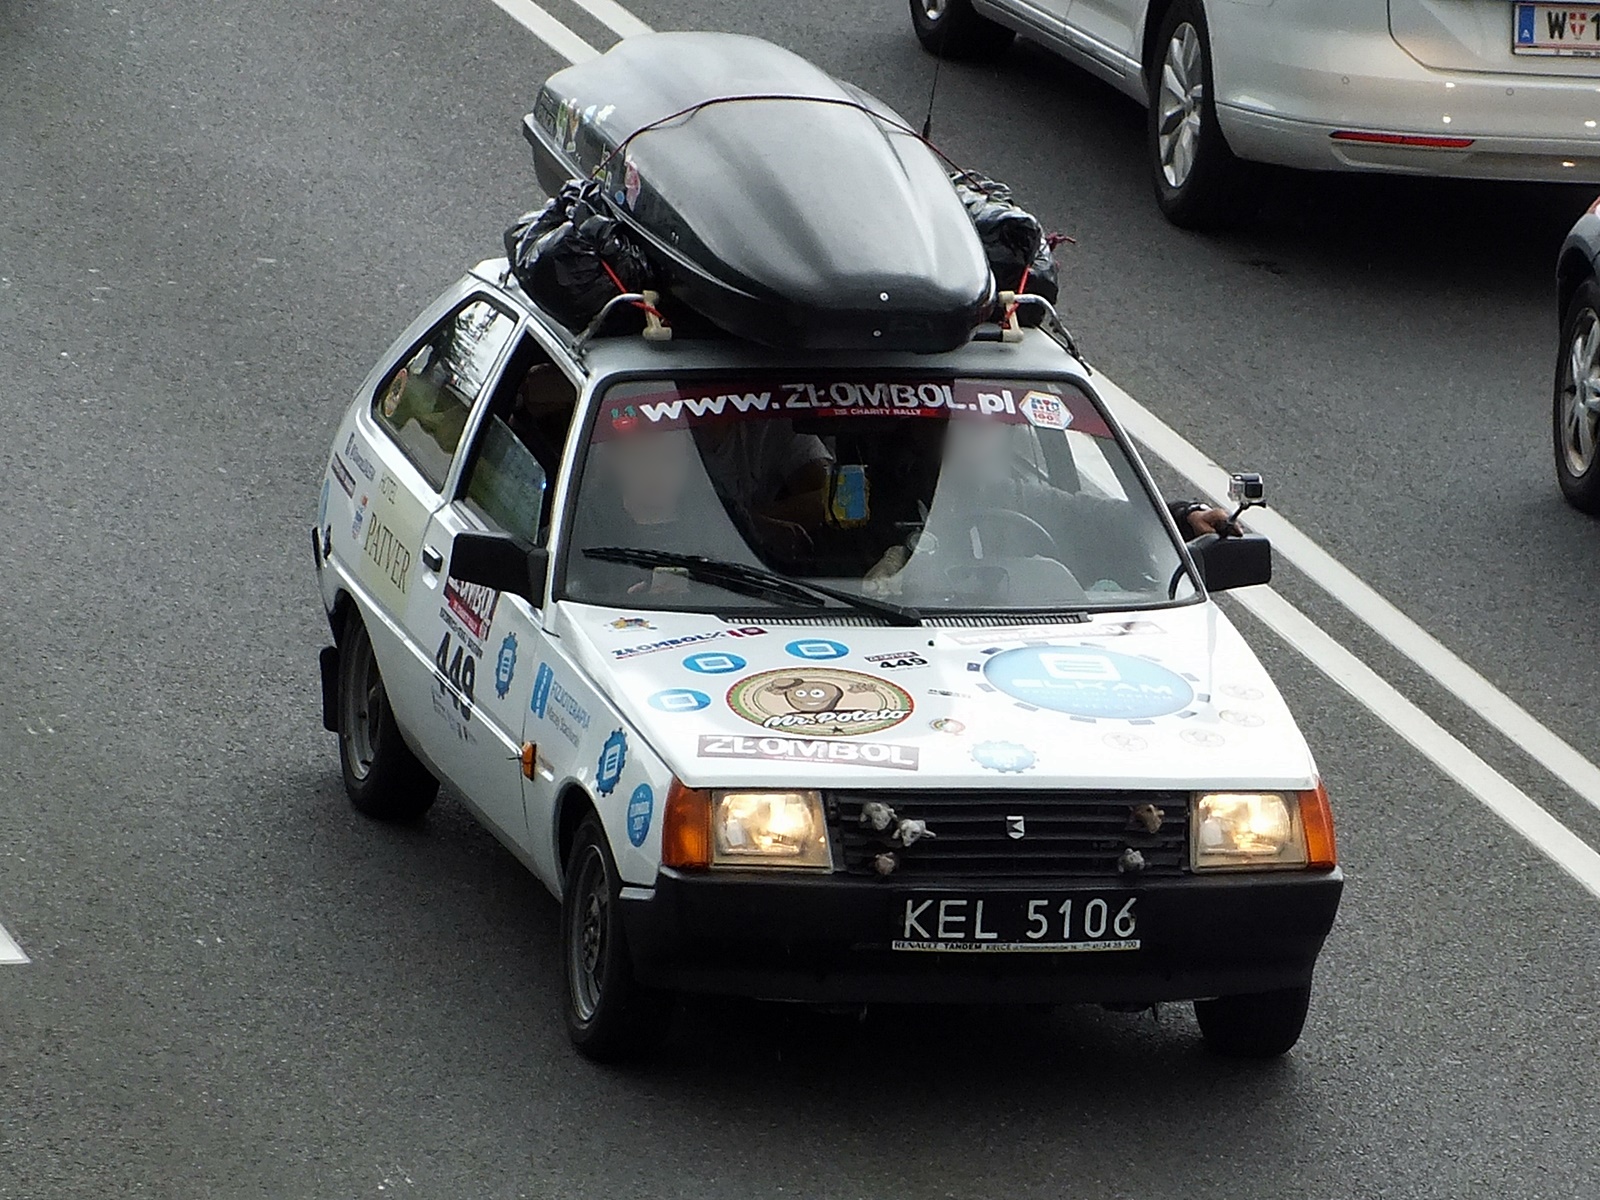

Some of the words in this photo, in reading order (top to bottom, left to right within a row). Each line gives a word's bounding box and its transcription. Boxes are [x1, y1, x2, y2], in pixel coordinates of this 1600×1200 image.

[1547, 11, 1567, 40] W
[433, 631, 476, 721] 449
[880, 658, 928, 668] 449
[817, 708, 910, 724] Potato
[705, 735, 916, 765] ZŁOMBOL
[903, 899, 998, 939] KEL
[1025, 897, 1137, 939] 5106
[943, 943, 982, 952] TANDEM
